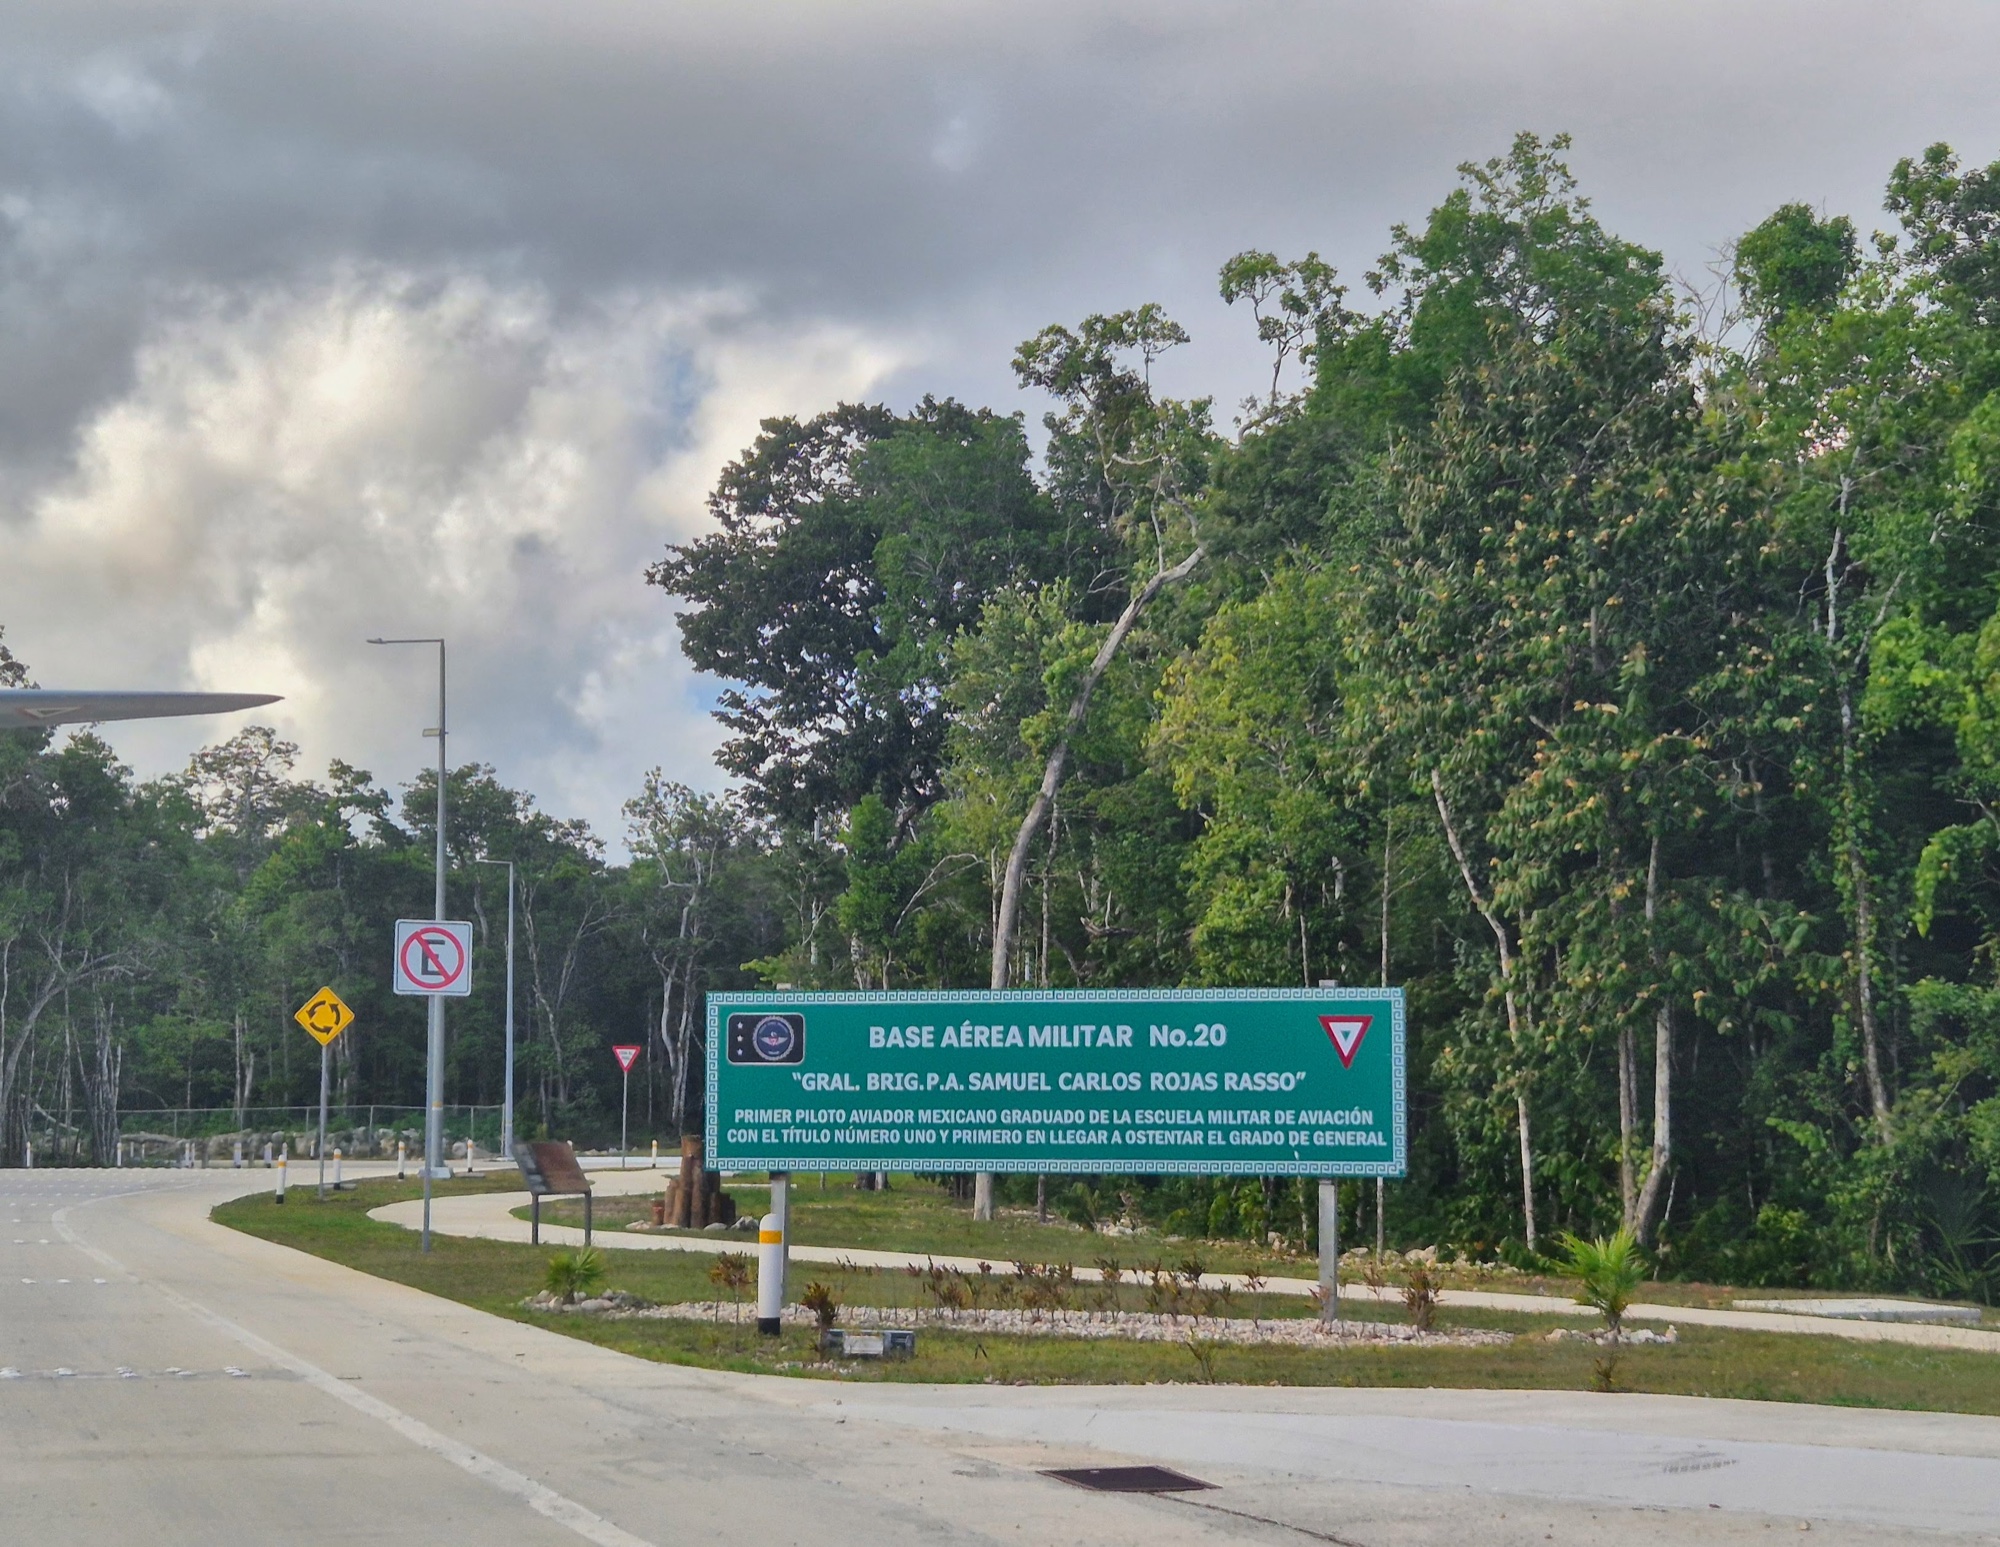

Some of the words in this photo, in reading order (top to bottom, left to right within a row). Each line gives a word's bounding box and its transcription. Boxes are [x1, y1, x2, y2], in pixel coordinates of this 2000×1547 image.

[421, 939, 445, 976] E
[869, 1025, 935, 1048] BASE
[940, 1020, 1024, 1048] AÉREA
[1028, 1025, 1133, 1047] MILITAR
[1149, 1023, 1227, 1047] No.20
[968, 1072, 1052, 1091] SAMUEL
[1058, 1072, 1142, 1091] CARLOS
[1150, 1072, 1218, 1091] ROJAS
[735, 1109, 792, 1123] PRIMER
[795, 1109, 846, 1124] PILOTO
[849, 1109, 914, 1123] AVIADOR
[918, 1109, 997, 1124] MEXICANO
[1000, 1109, 1085, 1124] GRADUADO
[1089, 1109, 1109, 1124] DE
[1113, 1109, 1132, 1124] LA
[1135, 1109, 1204, 1124] ESCUELA
[1208, 1110, 1271, 1125] MILITAR
[1274, 1110, 1295, 1125] DE
[1297, 1105, 1373, 1125] AVIACIÓN
[727, 1129, 758, 1143] CON
[762, 1129, 779, 1143] EL
[781, 1125, 831, 1143] TÍTULO
[834, 1125, 900, 1144] NÚMERO
[904, 1129, 937, 1144] UNO
[939, 1129, 949, 1143] Y
[952, 1129, 1022, 1144] PRIMERO
[1026, 1129, 1046, 1144] EN
[1049, 1129, 1108, 1144] LLEGAR
[1111, 1130, 1122, 1144] A
[1125, 1130, 1204, 1145] OSTENTAR
[1207, 1130, 1226, 1145] EL
[1229, 1130, 1285, 1145] GRADO
[1288, 1130, 1309, 1146] DE
[1313, 1130, 1387, 1146] GENERAL
